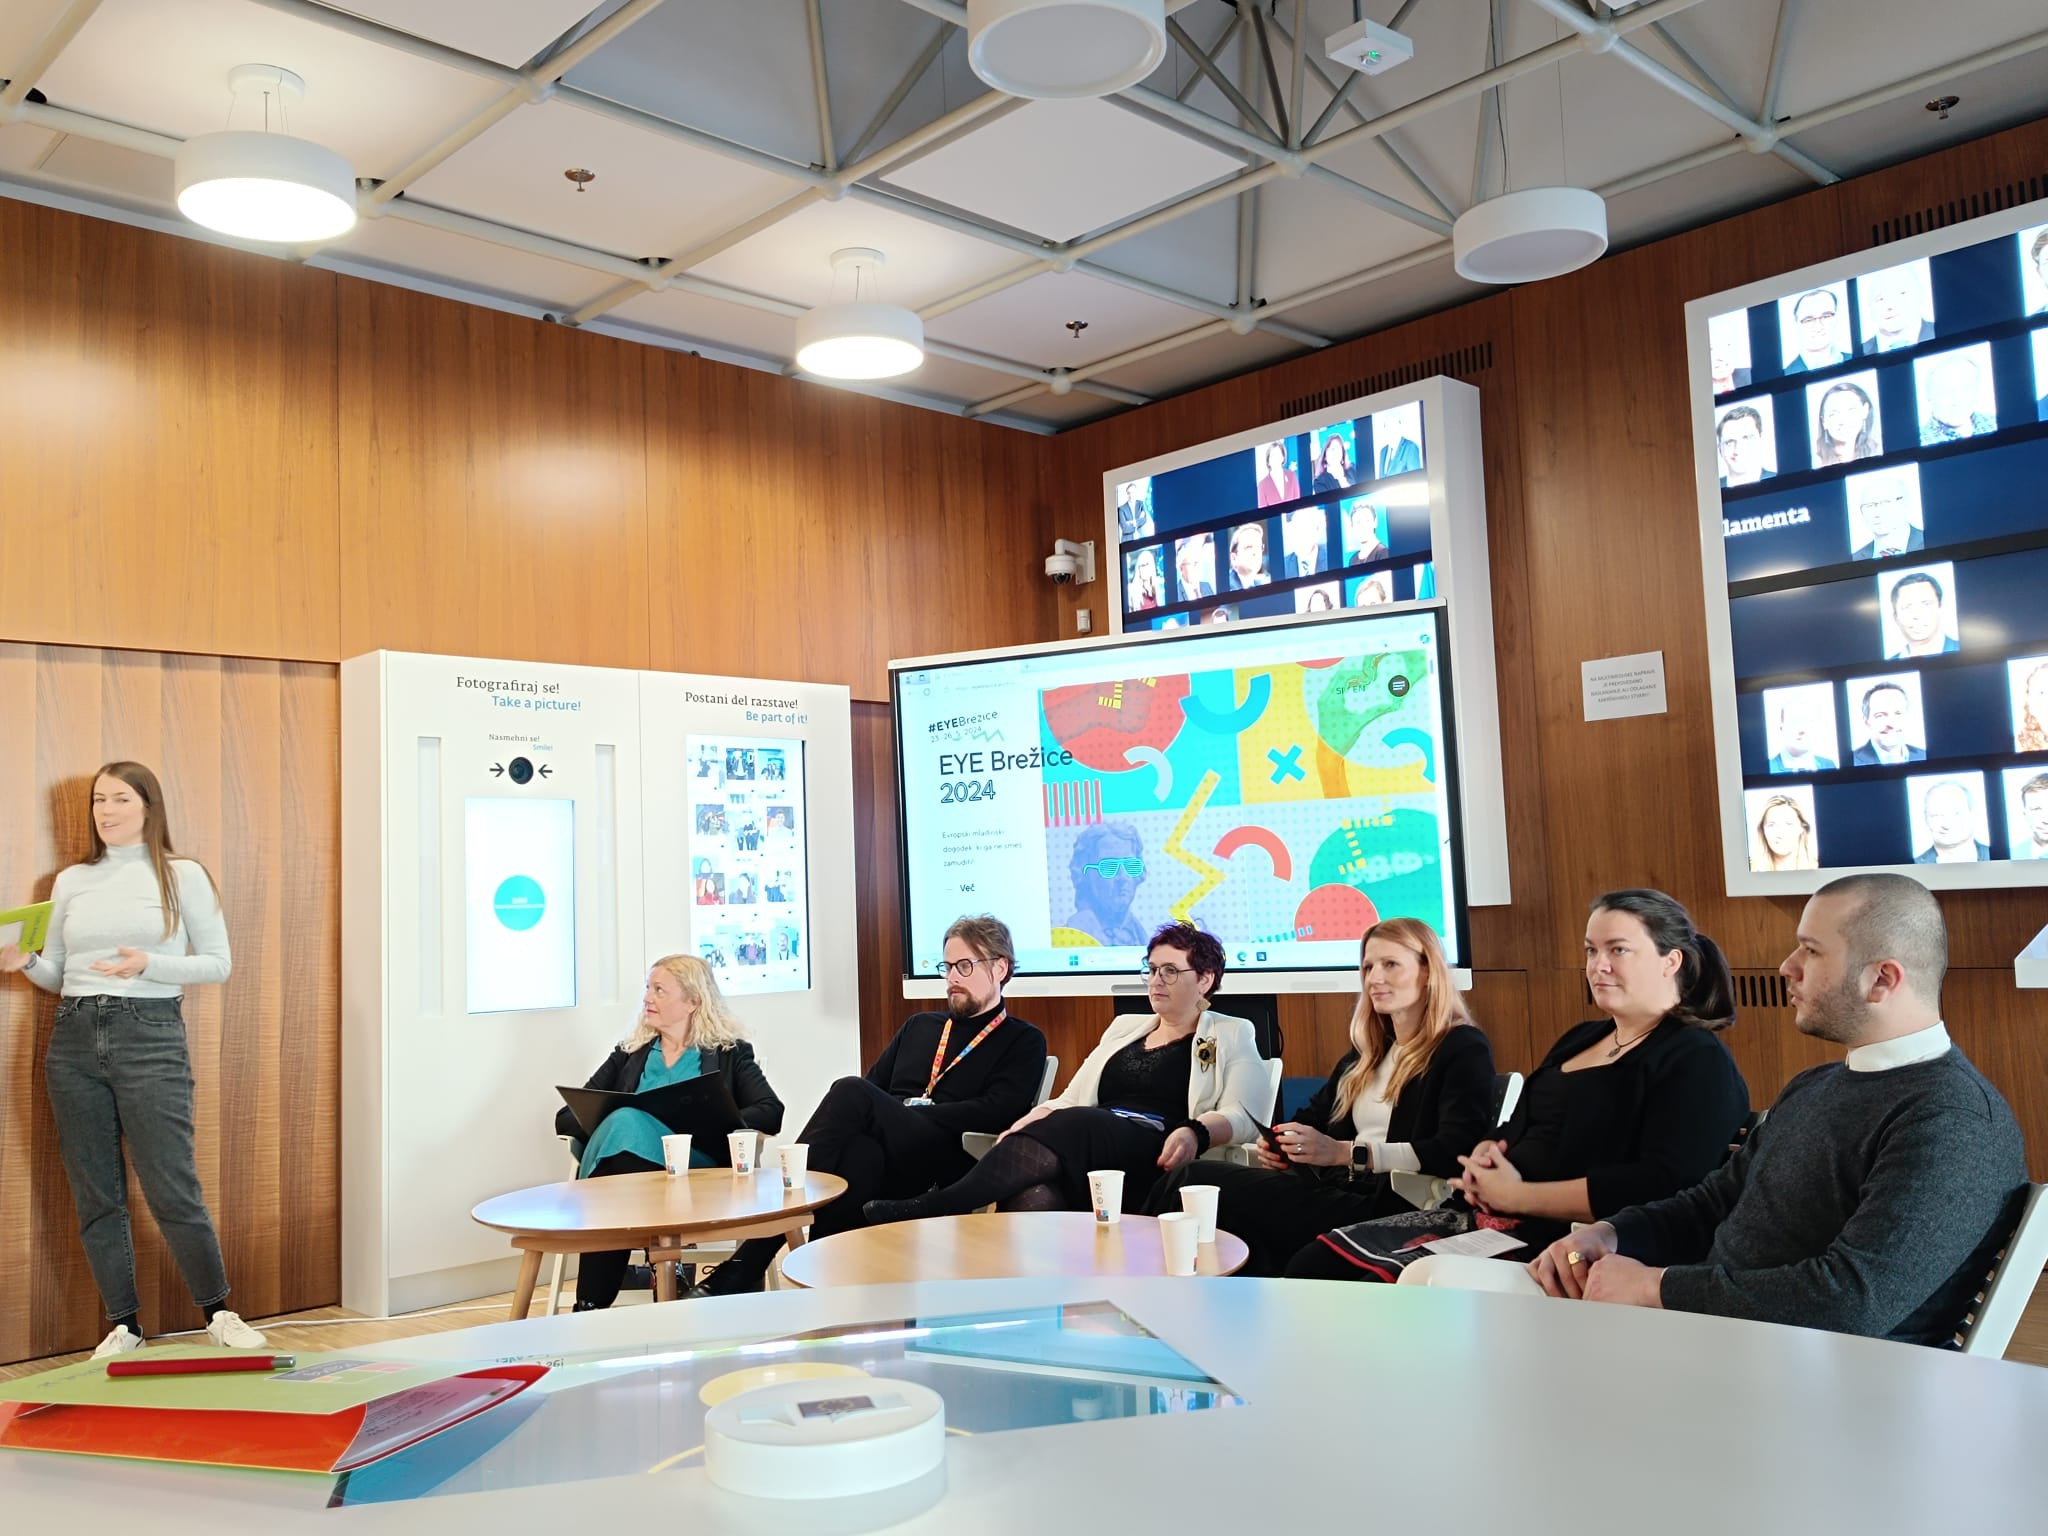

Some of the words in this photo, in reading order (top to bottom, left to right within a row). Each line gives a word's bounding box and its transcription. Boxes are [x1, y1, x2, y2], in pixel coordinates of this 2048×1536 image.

[456, 676, 538, 695] Fotografiraj
[543, 683, 560, 694] se!
[492, 696, 521, 708] Take
[524, 699, 531, 708] a
[535, 699, 581, 711] picture!
[685, 692, 728, 705] Postani
[731, 695, 748, 706] del
[751, 698, 798, 709] razstave!
[746, 711, 759, 721] Be
[761, 712, 783, 724] part
[785, 713, 795, 725] of
[798, 714, 808, 724] it!
[489, 733, 528, 742] Nasmehni
[940, 752, 984, 775] EYE
[991, 747, 1073, 770] Brežice
[940, 779, 996, 803] 2024
[960, 883, 975, 892] Več
